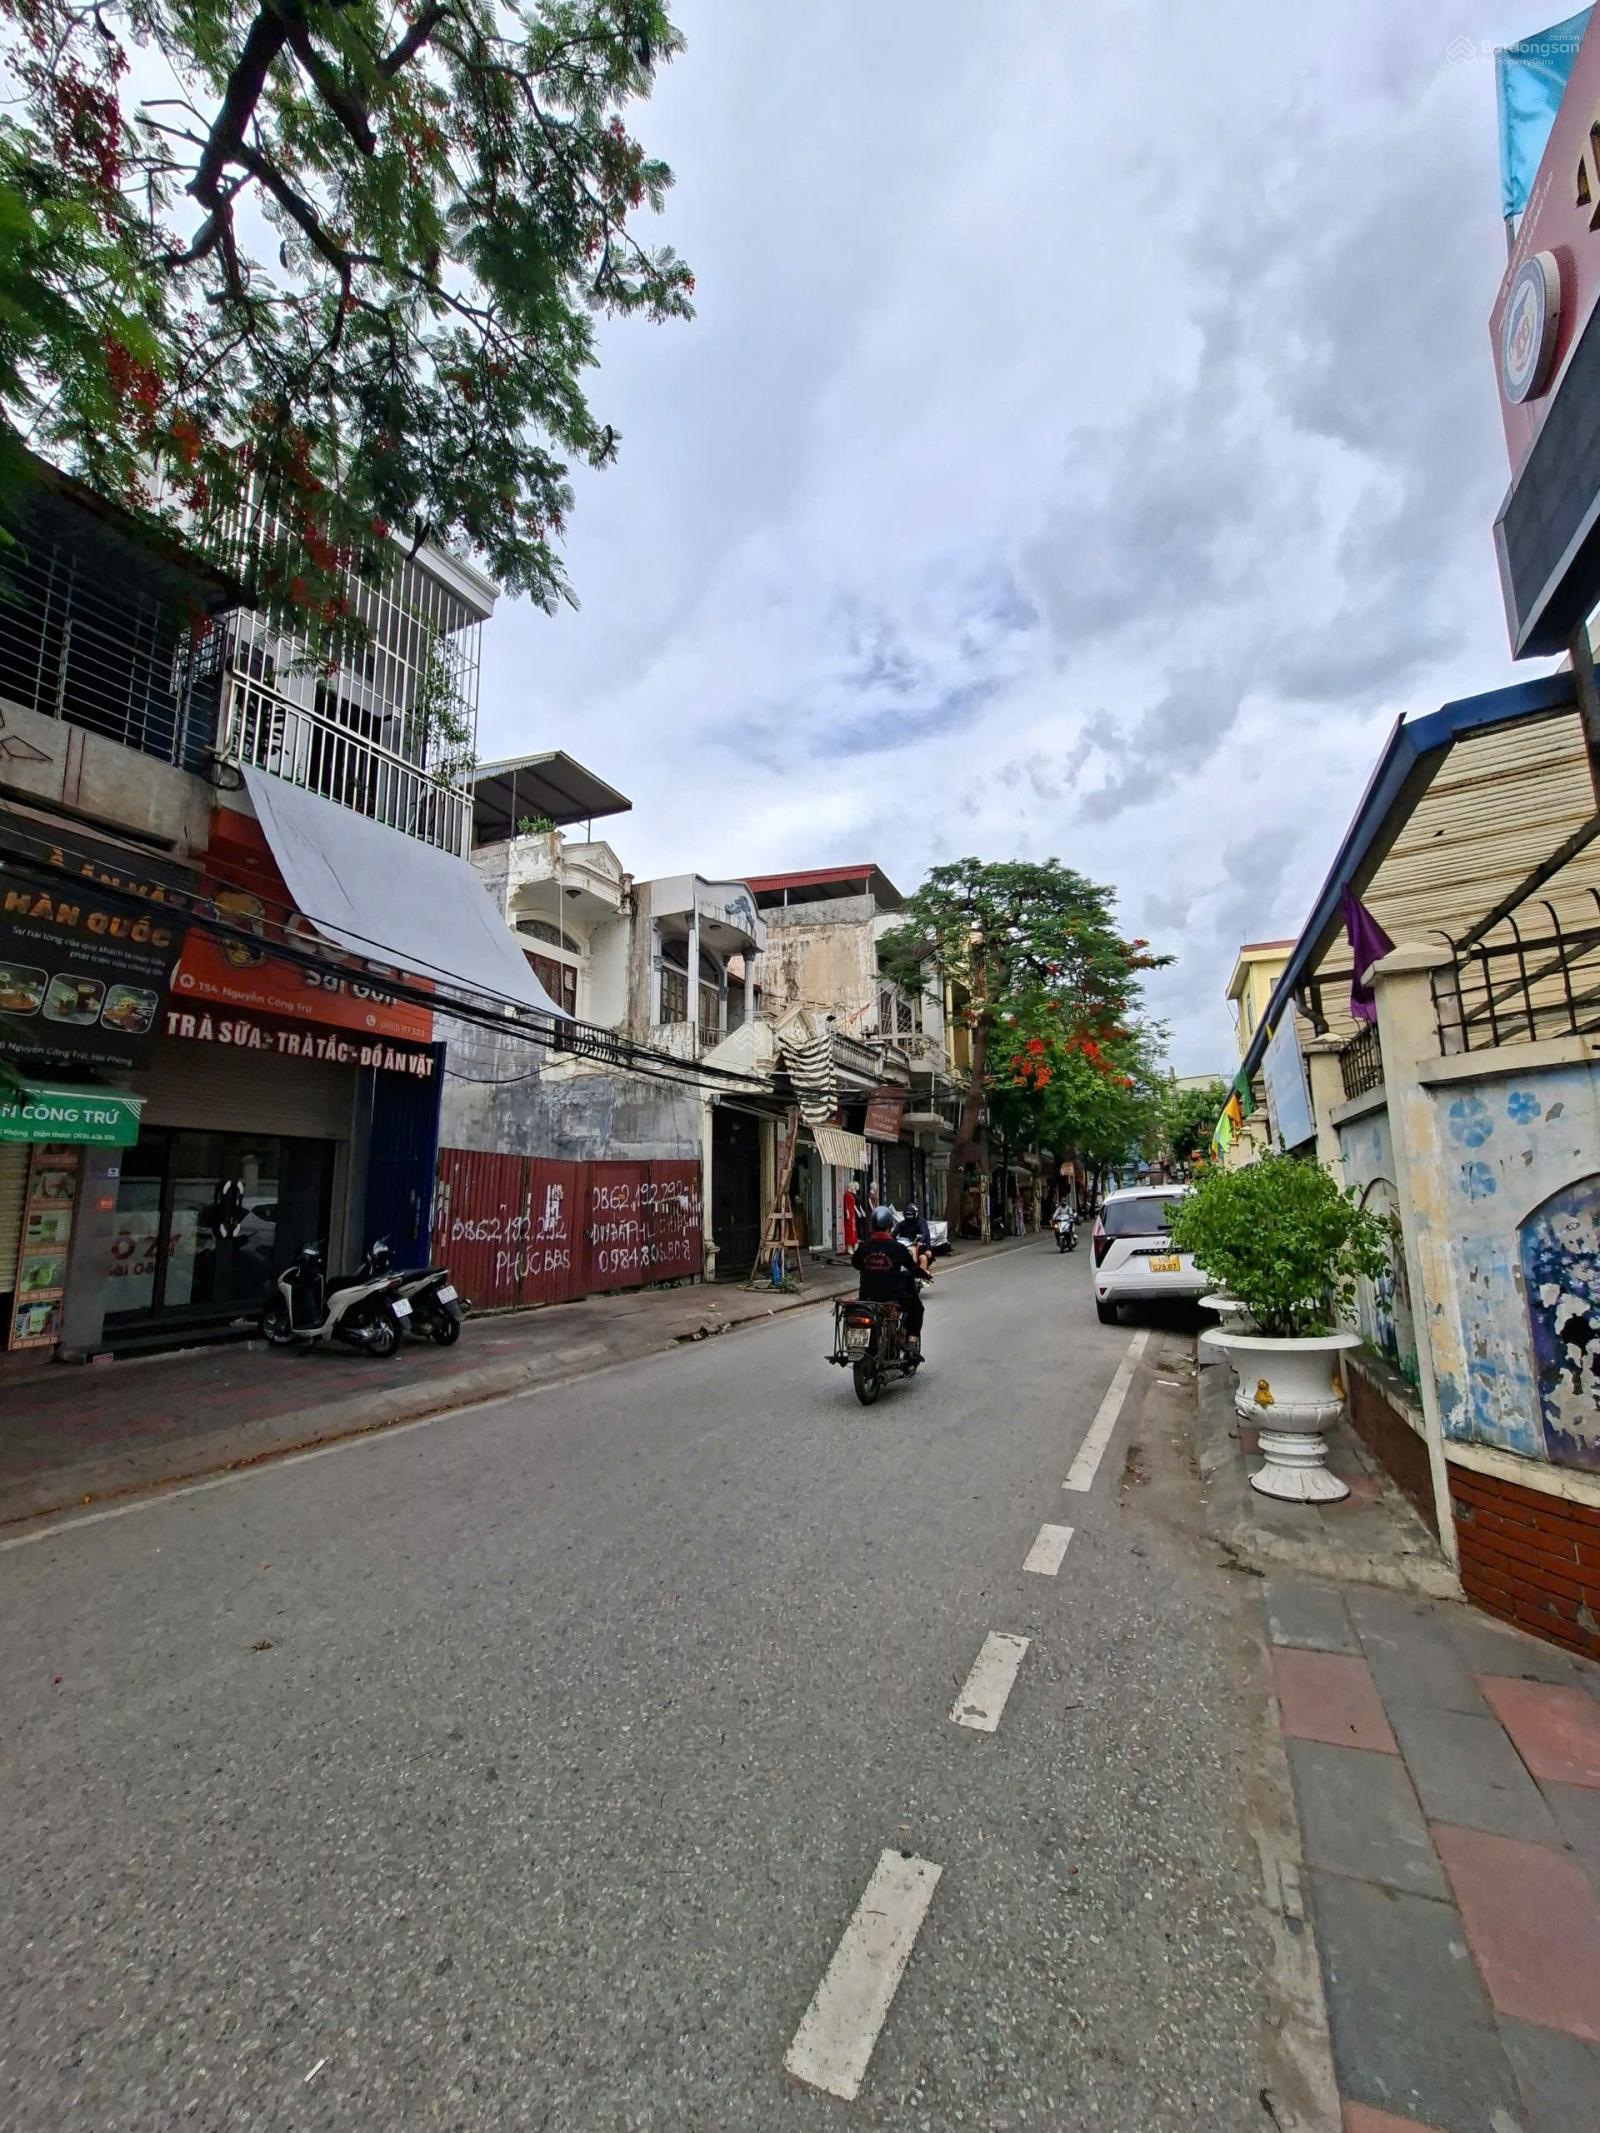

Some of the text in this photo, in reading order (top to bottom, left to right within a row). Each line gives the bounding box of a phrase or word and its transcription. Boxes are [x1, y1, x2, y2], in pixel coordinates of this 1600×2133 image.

[4, 890, 172, 947] HÀN QUỐC
[167, 1011, 213, 1040] TRÀ
[218, 1020, 261, 1049] SỮA
[278, 1027, 314, 1058] TRÀ
[316, 1034, 349, 1062] TẮC
[384, 1047, 407, 1072] ĂN
[22, 1103, 79, 1122] CÔNG
[83, 1108, 120, 1125] TRỨ
